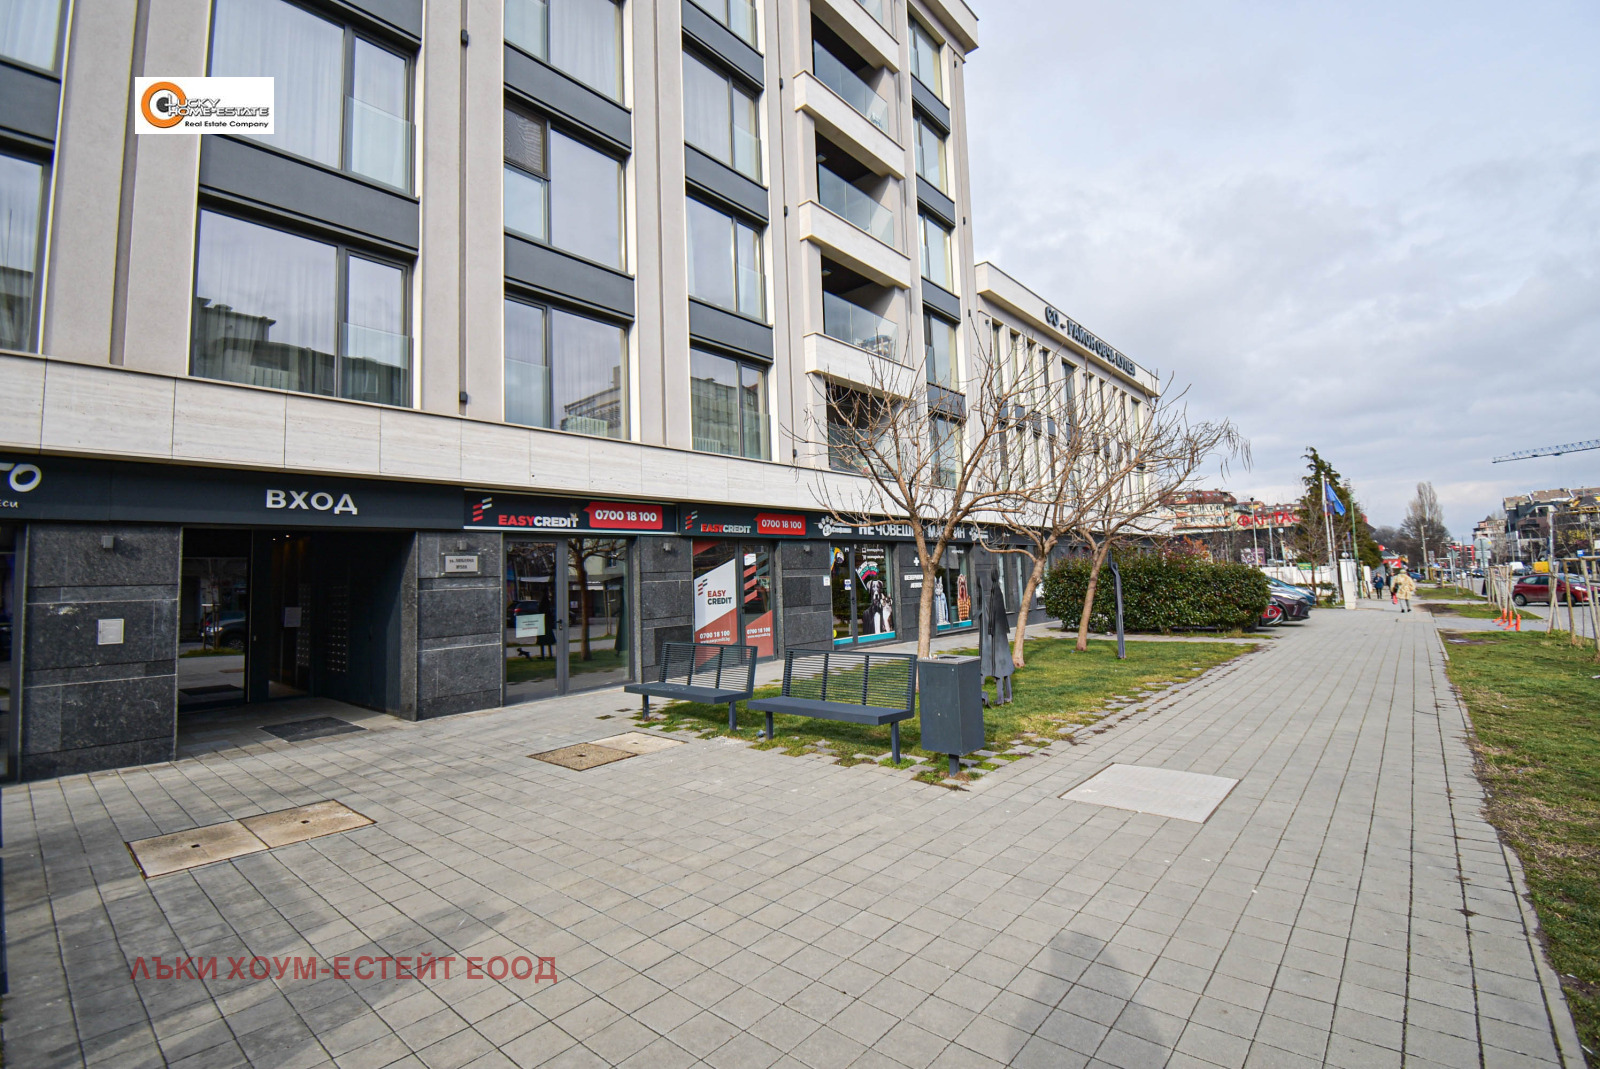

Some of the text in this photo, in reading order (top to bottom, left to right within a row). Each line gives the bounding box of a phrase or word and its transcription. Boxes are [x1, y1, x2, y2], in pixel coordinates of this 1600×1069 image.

[265, 489, 358, 515] ВХОД
[498, 509, 657, 528] EASYCREDIT 0700 18 100
[700, 519, 802, 534] EASYCREDIT 0700 18 100
[707, 590, 726, 598] EASY
[707, 597, 732, 605] CREDIT
